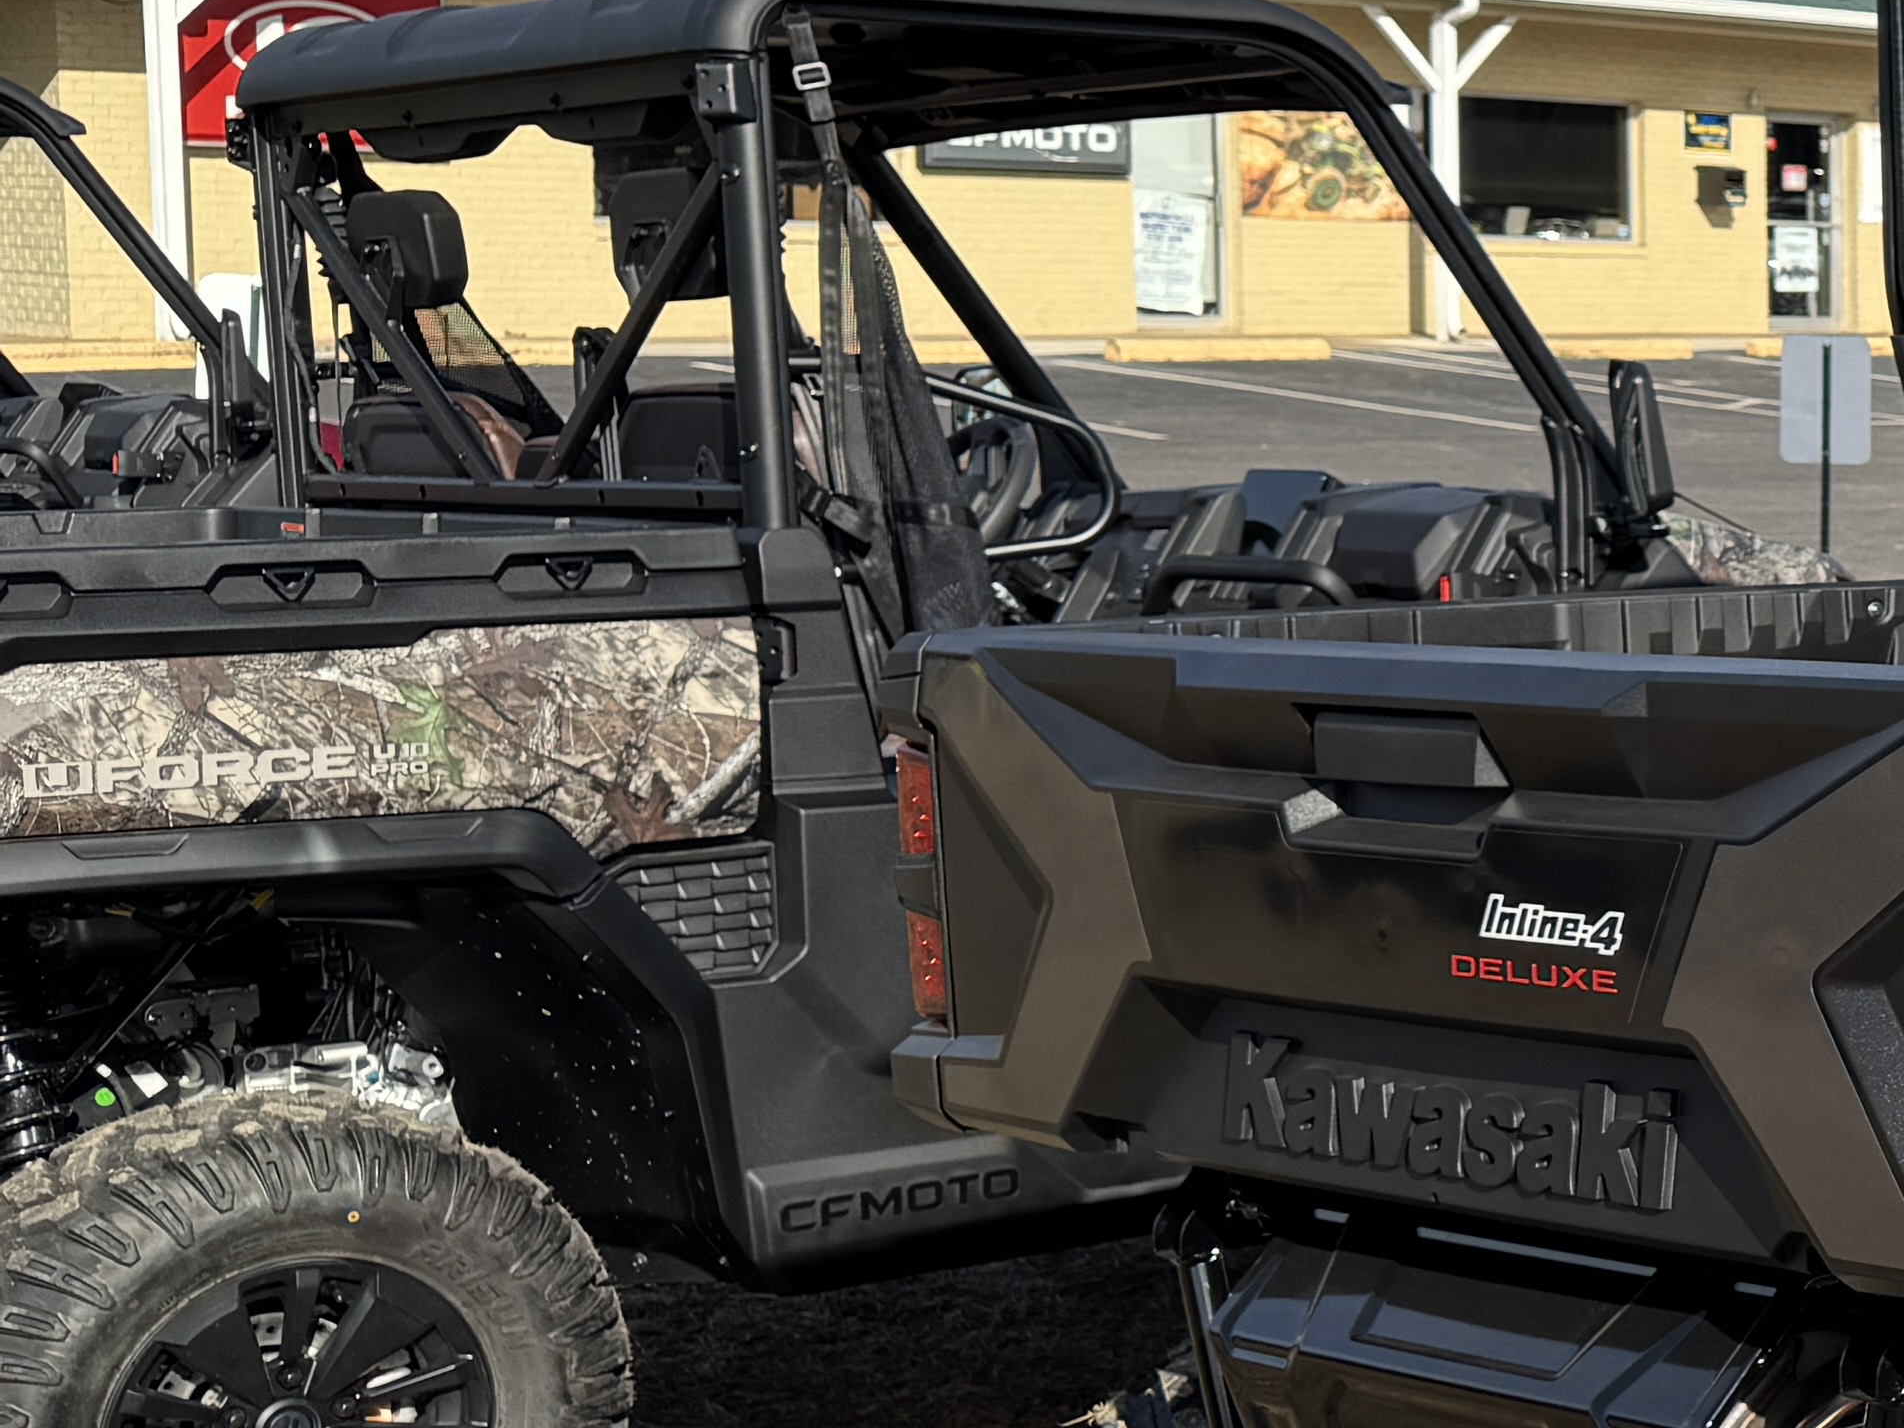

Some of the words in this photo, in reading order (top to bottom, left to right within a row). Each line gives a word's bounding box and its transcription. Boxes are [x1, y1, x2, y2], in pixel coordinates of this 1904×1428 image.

[370, 759, 430, 775] PRO
[1450, 955, 1619, 994] DELUXE
[1221, 1031, 1683, 1211] Kawasaki
[780, 1168, 1019, 1233] CFMOTO
